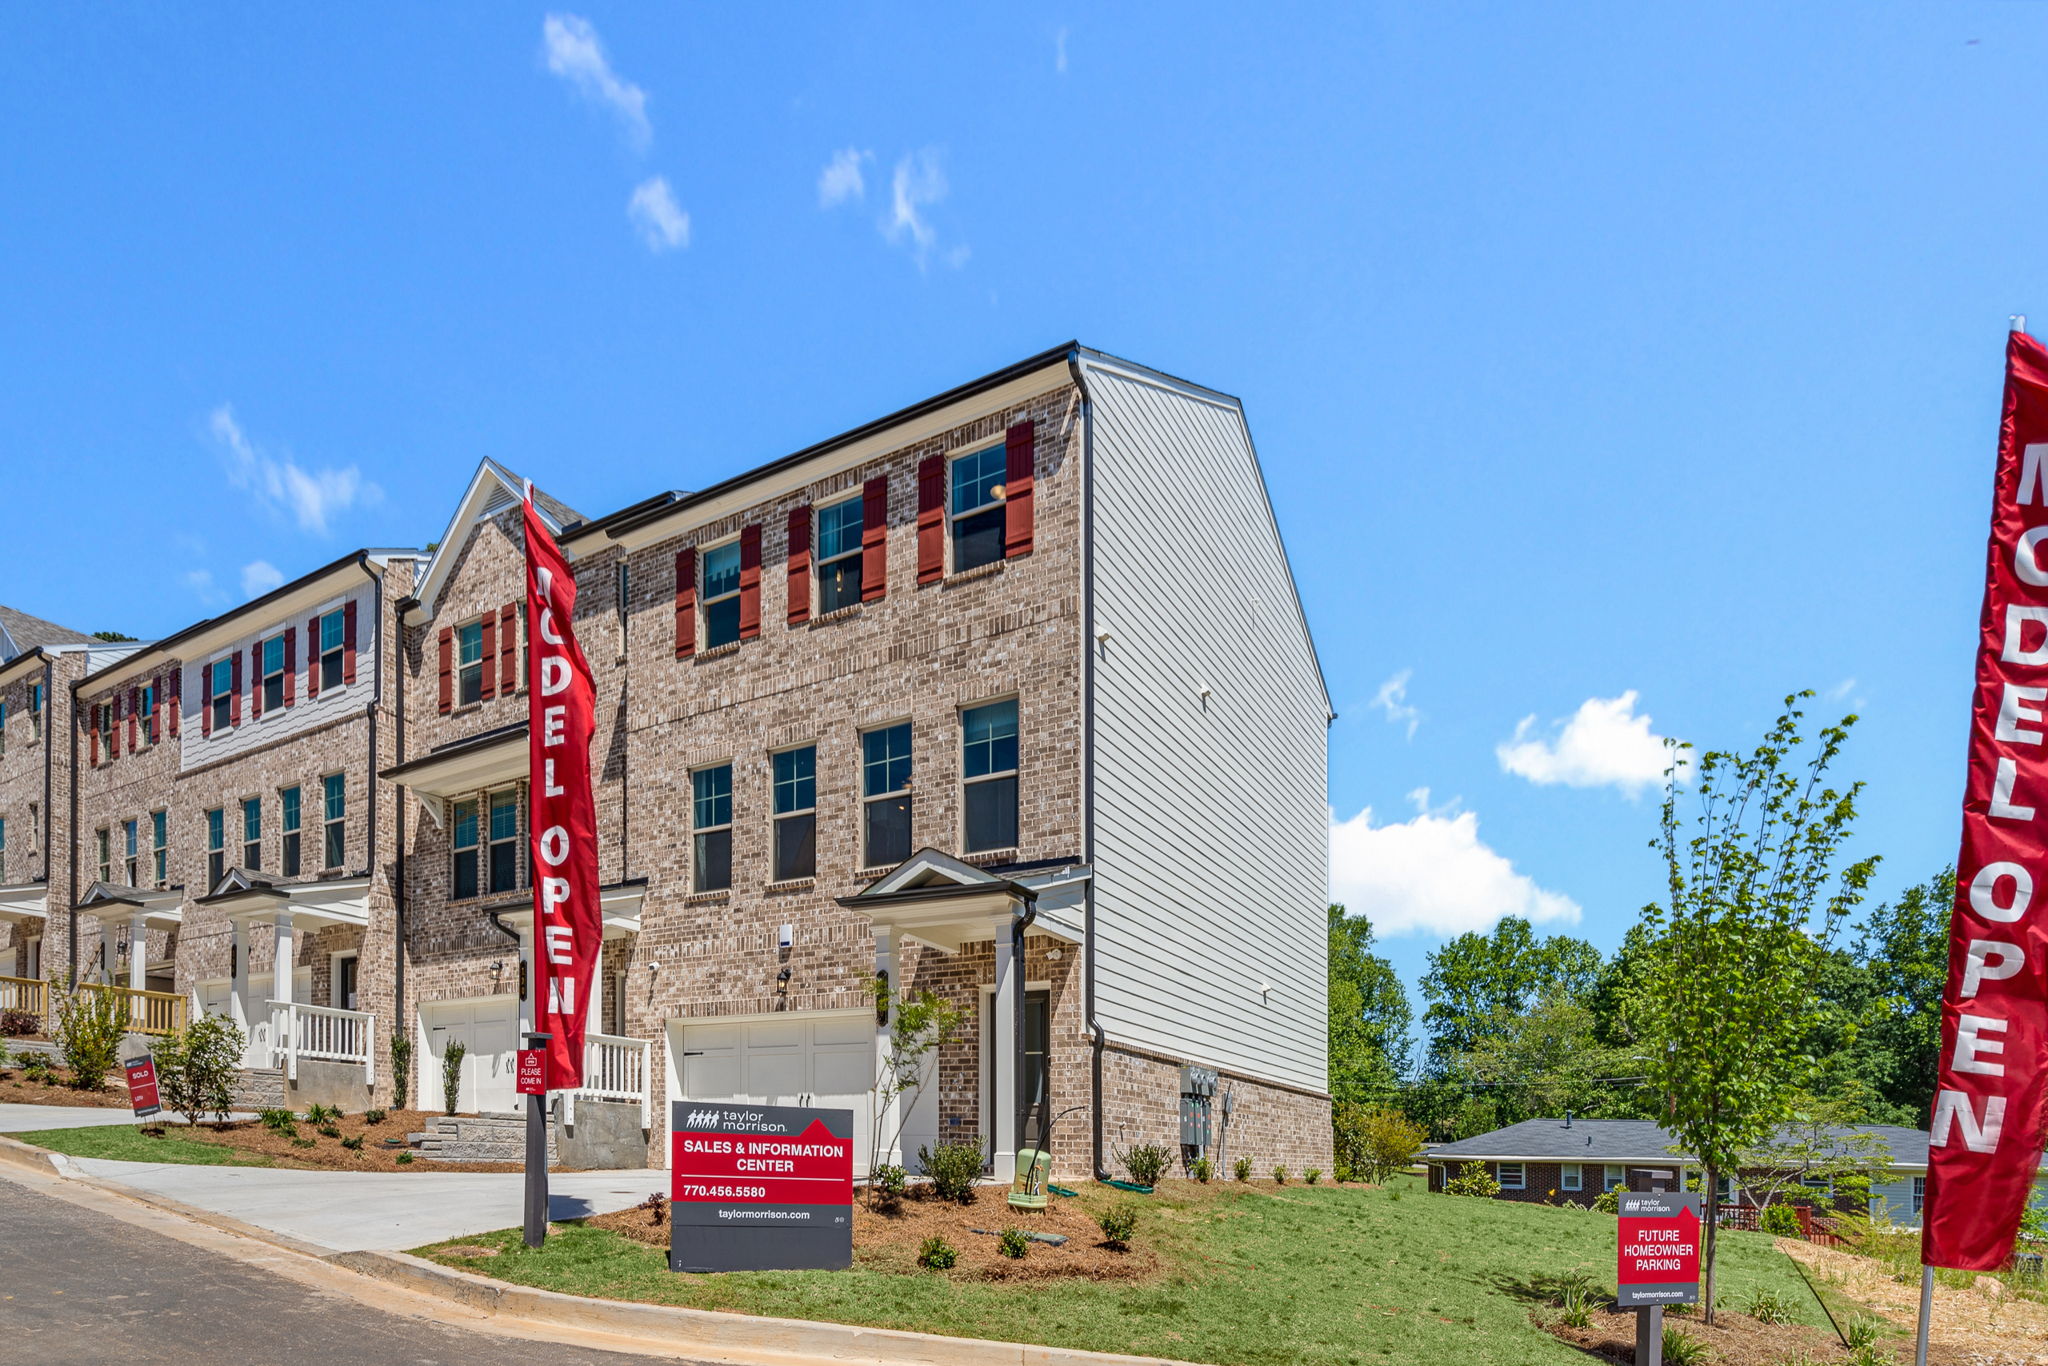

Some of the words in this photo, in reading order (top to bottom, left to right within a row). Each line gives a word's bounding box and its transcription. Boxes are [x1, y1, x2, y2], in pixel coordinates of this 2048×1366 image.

[540, 825, 575, 1015] OPEN
[1930, 861, 2033, 1155] OPEN
[132, 1070, 148, 1079] SOLD
[723, 1110, 764, 1123] taylor
[684, 1140, 732, 1154] SALES
[735, 1143, 745, 1154] &
[749, 1143, 843, 1157] INFORMATION
[736, 1159, 794, 1172] CENTER
[683, 1185, 766, 1197] 770.456.5580
[1641, 1199, 1660, 1207] taylor
[718, 1209, 810, 1219] taylormorrison.com
[1638, 1230, 1680, 1242] FUTURE
[1624, 1244, 1693, 1257] HOMEOWNER
[1636, 1259, 1681, 1271] PARKING
[1632, 1291, 1683, 1300] taylormorrison.com
